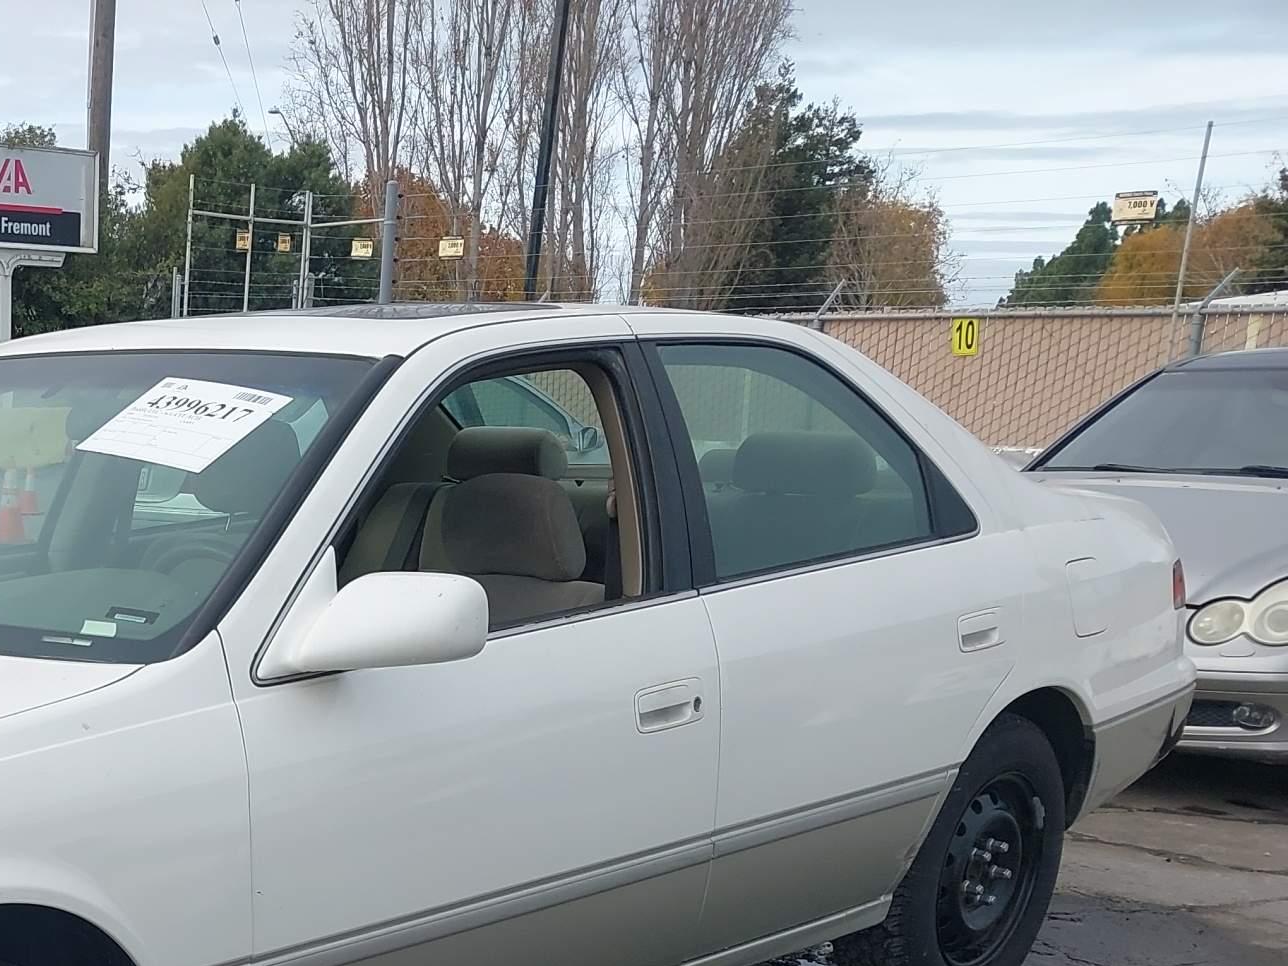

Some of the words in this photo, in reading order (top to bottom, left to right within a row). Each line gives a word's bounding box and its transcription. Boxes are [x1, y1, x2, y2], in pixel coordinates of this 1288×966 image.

[1, 216, 51, 237] Fremont
[956, 319, 975, 350] 10
[147, 394, 255, 424] 43996217
